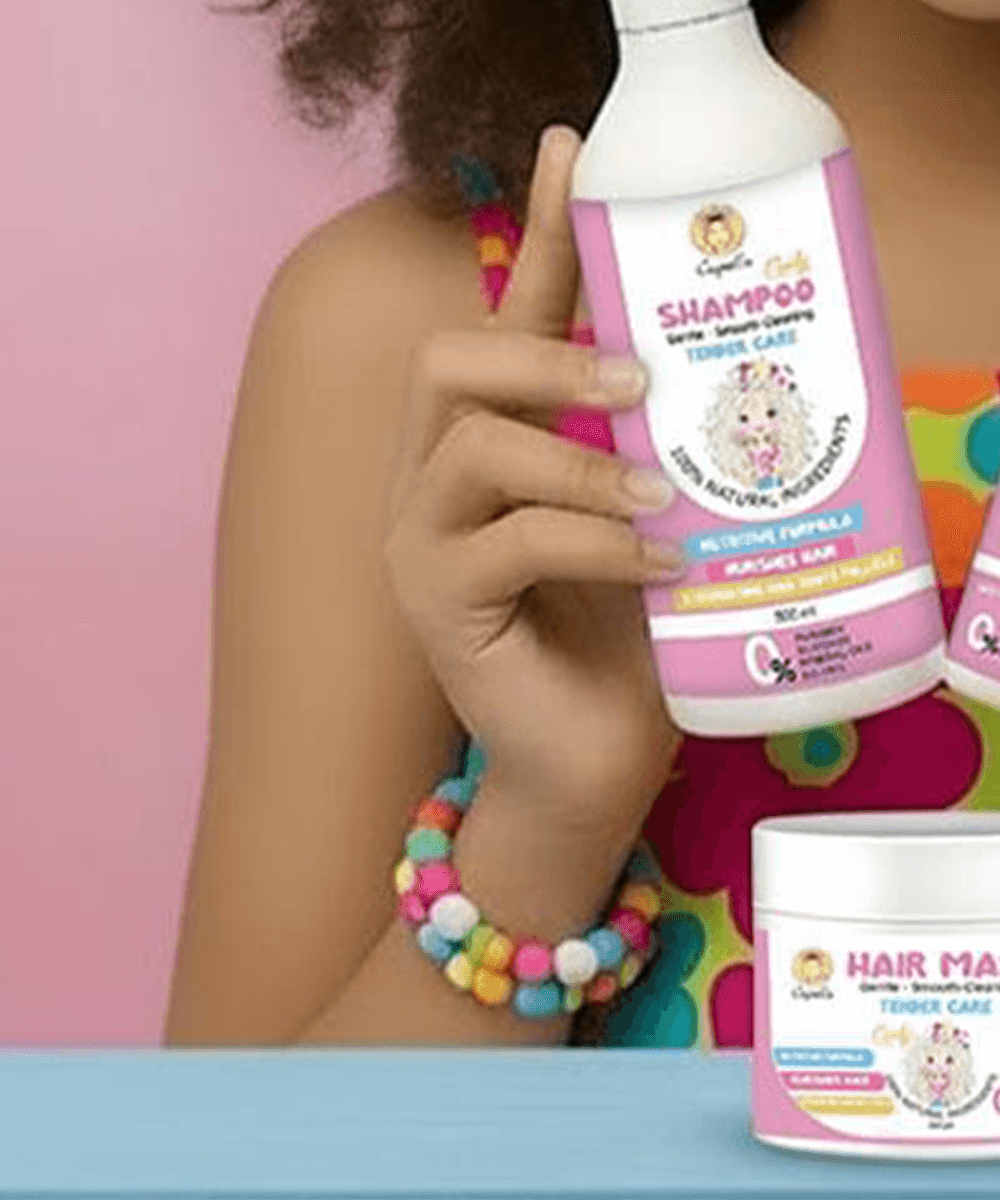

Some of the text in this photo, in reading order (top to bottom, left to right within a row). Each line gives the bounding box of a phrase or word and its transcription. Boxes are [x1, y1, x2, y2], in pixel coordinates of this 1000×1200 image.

[657, 278, 815, 328] SHAMPOO
[687, 329, 797, 364] TENDER CARE
[704, 478, 779, 508] NATURAL
[781, 413, 851, 503] INGREDIENTS
[846, 951, 927, 978] HAIR
[881, 998, 993, 1015] TENDER CARE
